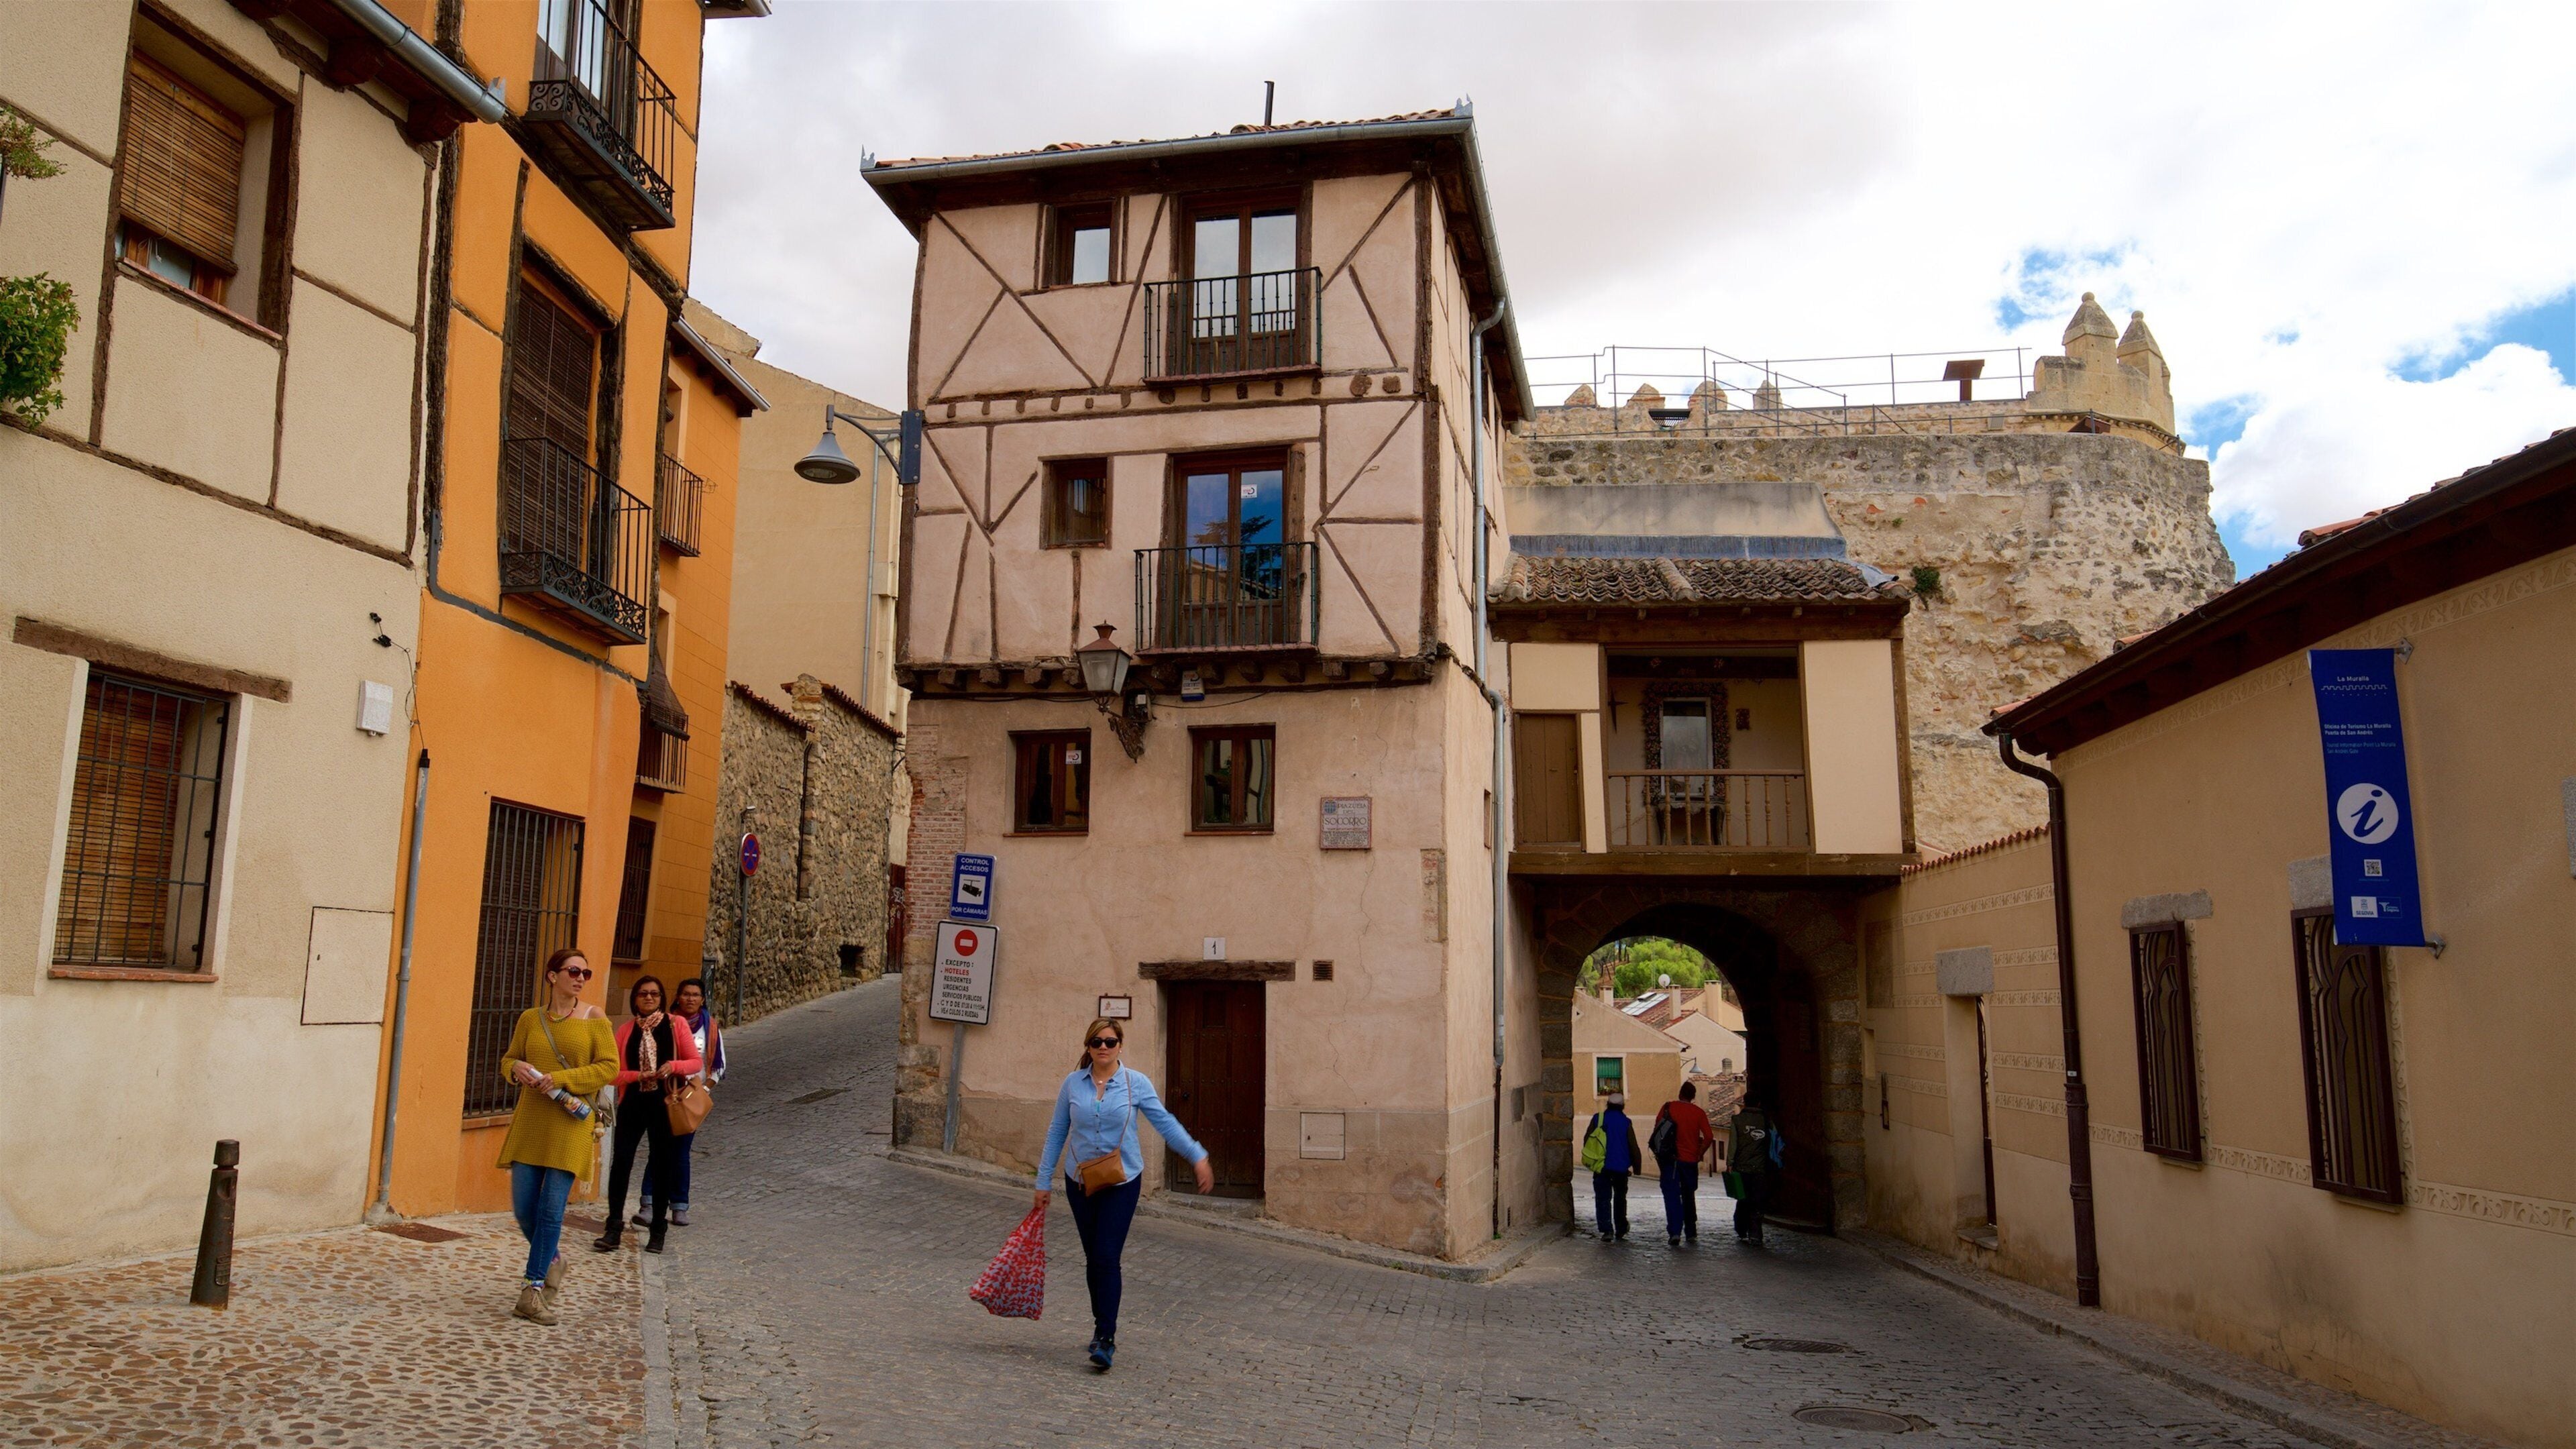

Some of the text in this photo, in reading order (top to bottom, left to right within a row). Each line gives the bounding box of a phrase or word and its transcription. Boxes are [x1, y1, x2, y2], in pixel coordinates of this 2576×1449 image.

[1325, 817, 1366, 826] SOCORRO
[1212, 940, 1216, 955] 1
[944, 967, 969, 976] HOTELES
[944, 975, 972, 984] RESIDENTES
